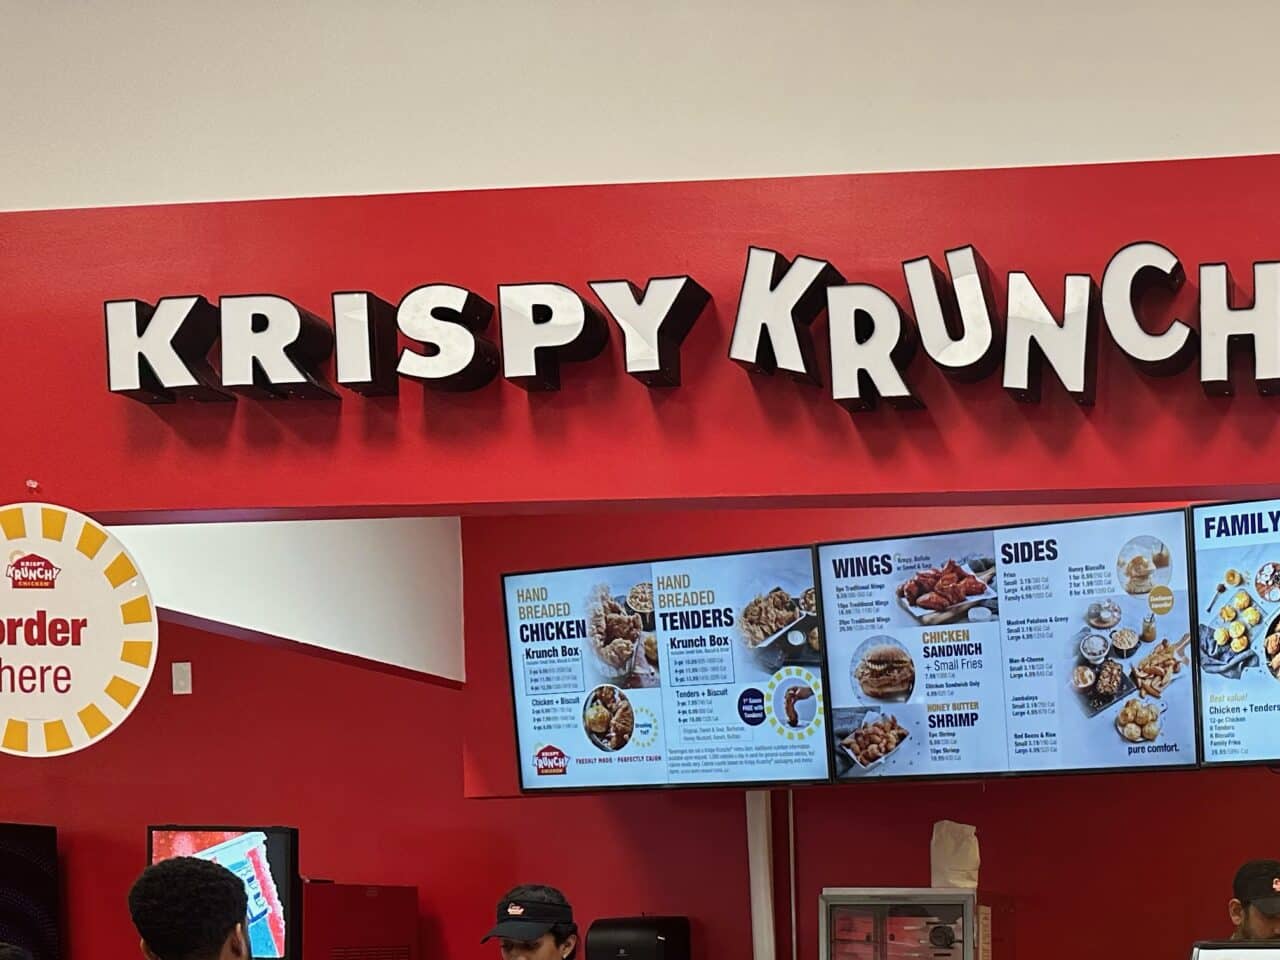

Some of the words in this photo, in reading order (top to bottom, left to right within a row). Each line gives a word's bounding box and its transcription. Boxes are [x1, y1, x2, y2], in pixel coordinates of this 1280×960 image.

[105, 275, 700, 396] KRISPY
[1001, 539, 1058, 564] SIDES
[6, 564, 62, 581] KRUNCHY
[832, 554, 893, 578] WINGS
[657, 574, 690, 590] HAND
[516, 587, 548, 603] HAND
[659, 590, 715, 608] BREADED
[519, 602, 570, 621] BREADED
[659, 608, 734, 631] TENDERS
[520, 619, 587, 643] CHICKEN
[922, 629, 970, 644] CHICKEN
[670, 636, 706, 649] Krunch
[709, 635, 729, 647] Box
[525, 646, 559, 660] Krunch
[561, 645, 580, 657] Box
[923, 643, 983, 659] SANDWICH
[934, 660, 959, 672] Small
[961, 658, 983, 670] Fries
[0, 657, 71, 693] here
[676, 690, 700, 699] Tenders
[707, 688, 728, 697] Biscuit
[927, 703, 950, 713] HONEY
[952, 701, 979, 712] BUTTER
[1209, 706, 1241, 715] Chicken
[928, 712, 979, 729] SHRIMP
[1128, 745, 1146, 756] pure
[1147, 743, 1180, 754] comfort.
